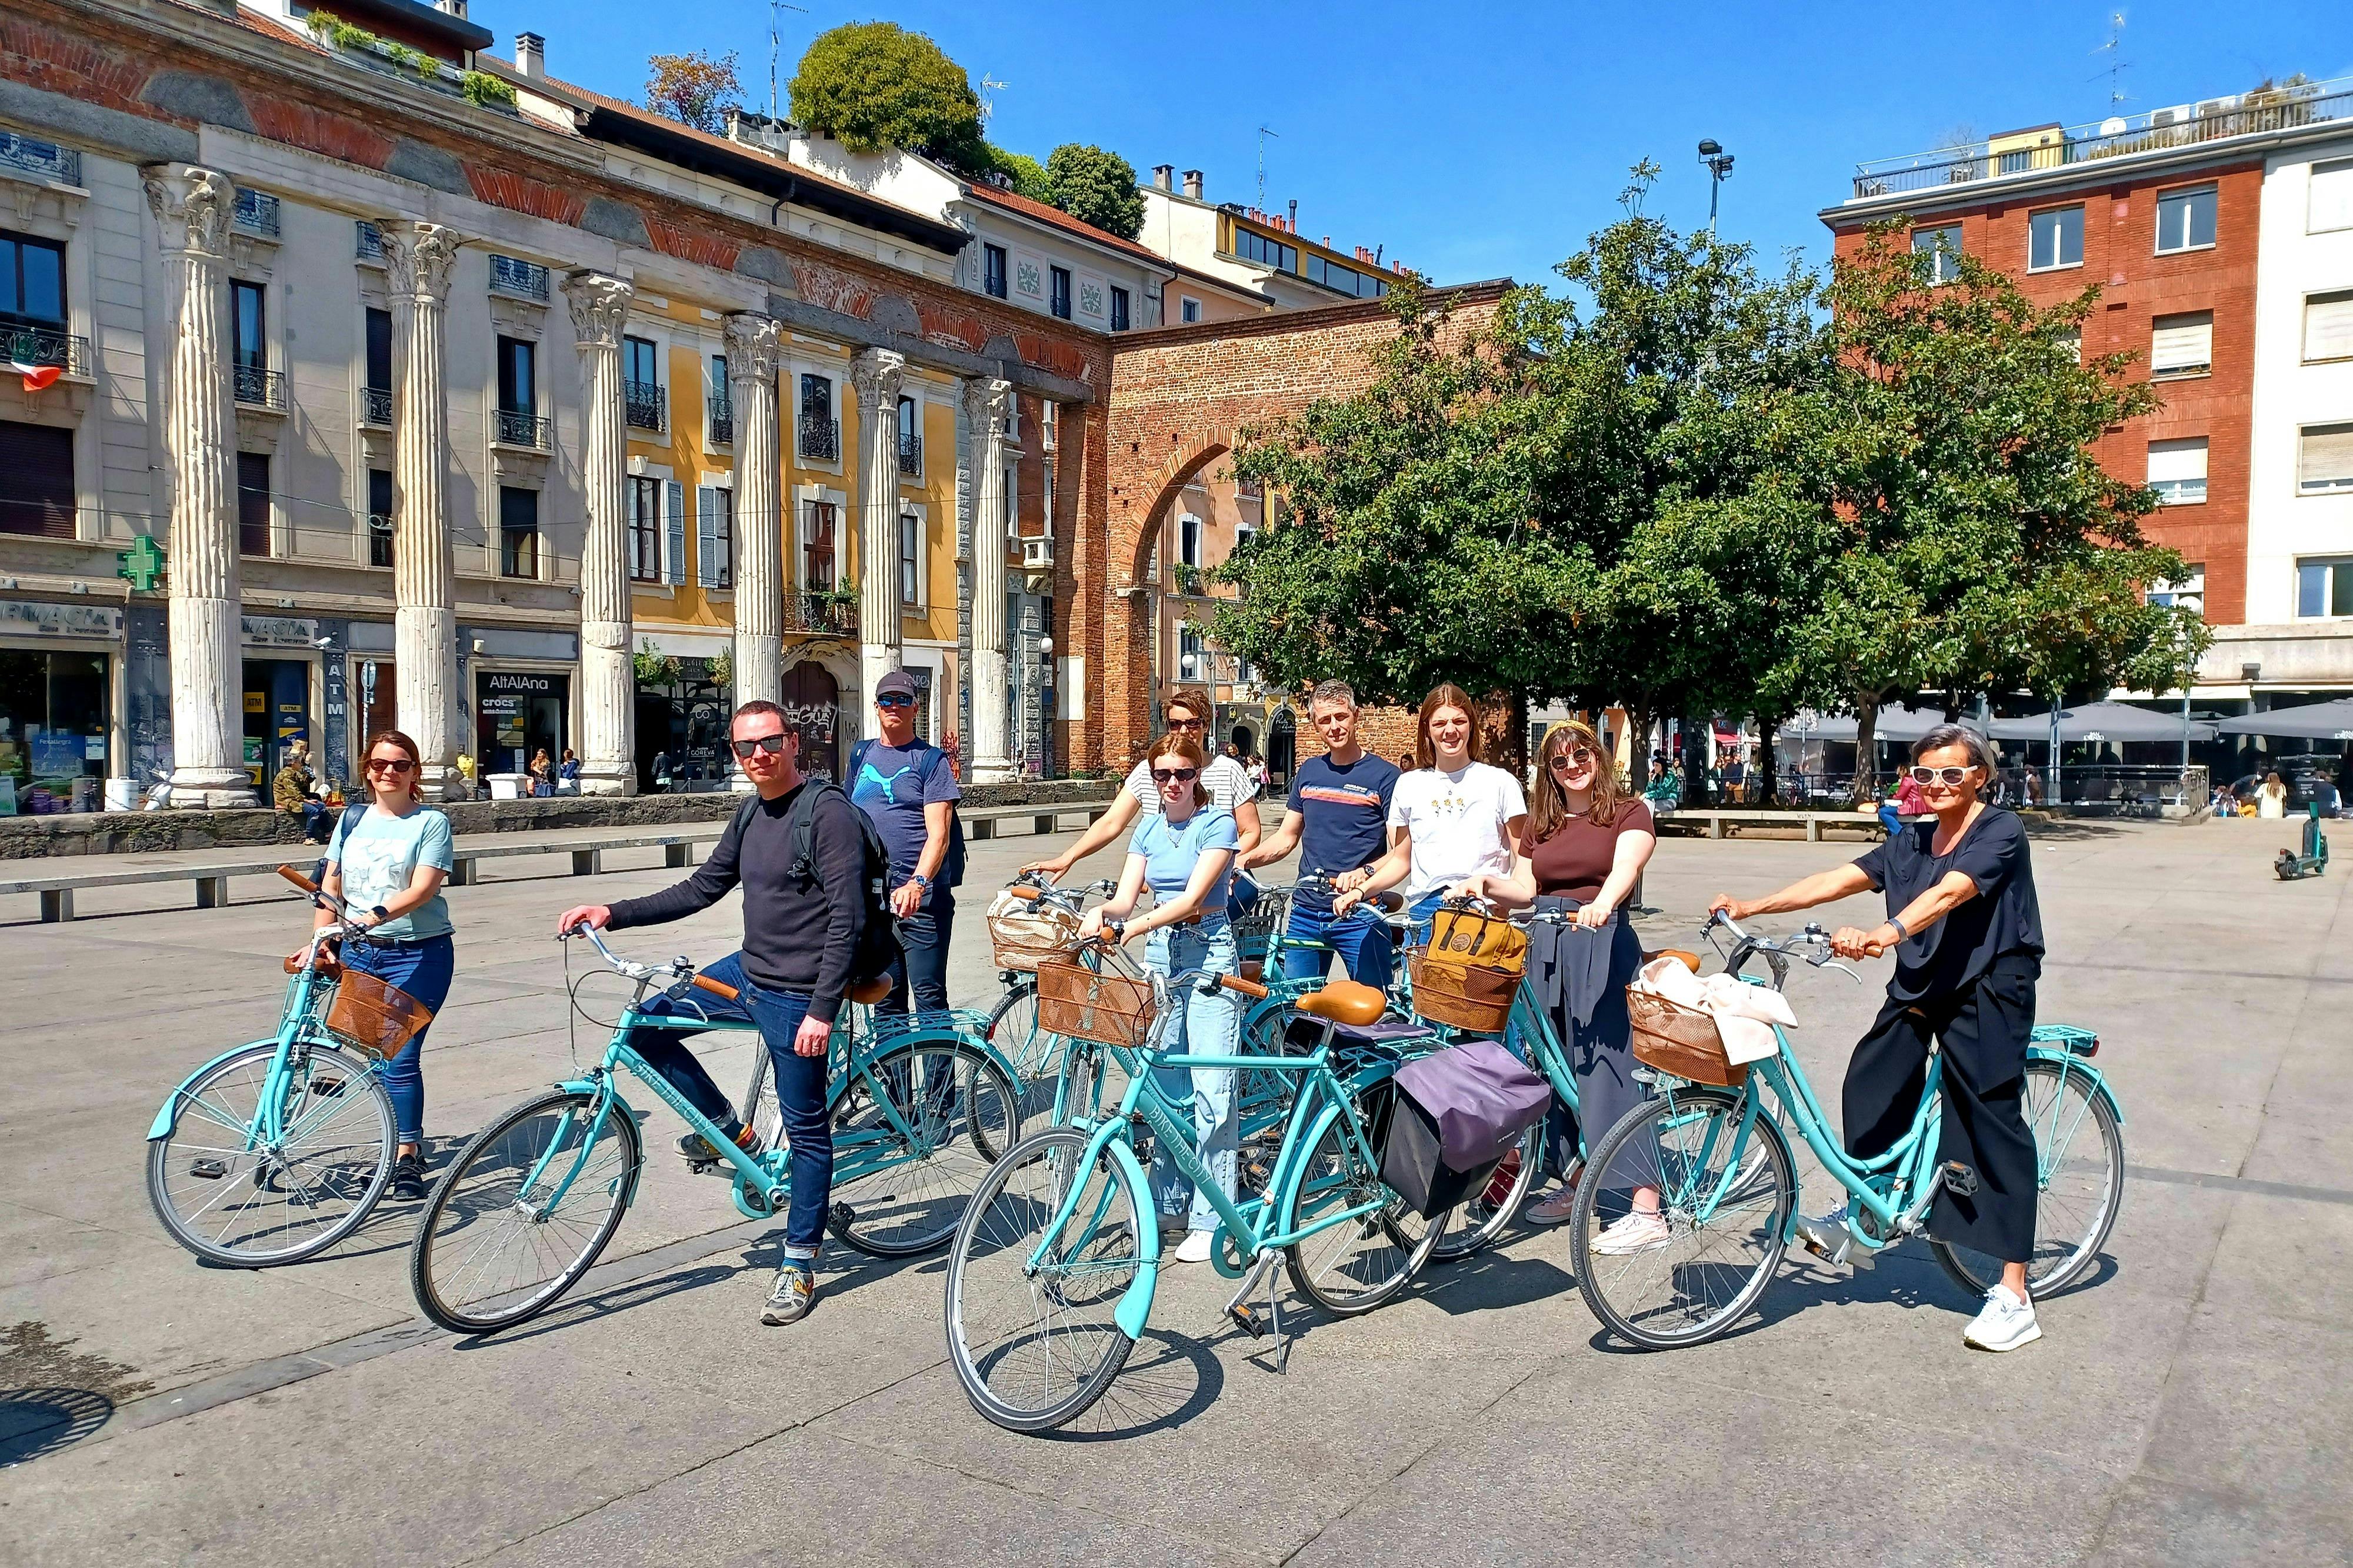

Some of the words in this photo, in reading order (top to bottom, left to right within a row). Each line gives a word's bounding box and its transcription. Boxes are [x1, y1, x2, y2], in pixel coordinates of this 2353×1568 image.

[0, 604, 109, 626] RMACIA
[247, 698, 262, 706] ATM
[328, 665, 343, 715] ATM
[482, 699, 515, 707] crocs
[1525, 1020, 1538, 1040] BIKE
[633, 1061, 664, 1090] BIKE
[661, 1084, 687, 1110] THE
[684, 1106, 712, 1132] CITY
[1774, 1070, 1789, 1093] BIKE
[1801, 1109, 1817, 1132] CITY
[1149, 1105, 1172, 1138] BIKE
[1171, 1134, 1189, 1161] THE
[1188, 1156, 1211, 1185] CITY
